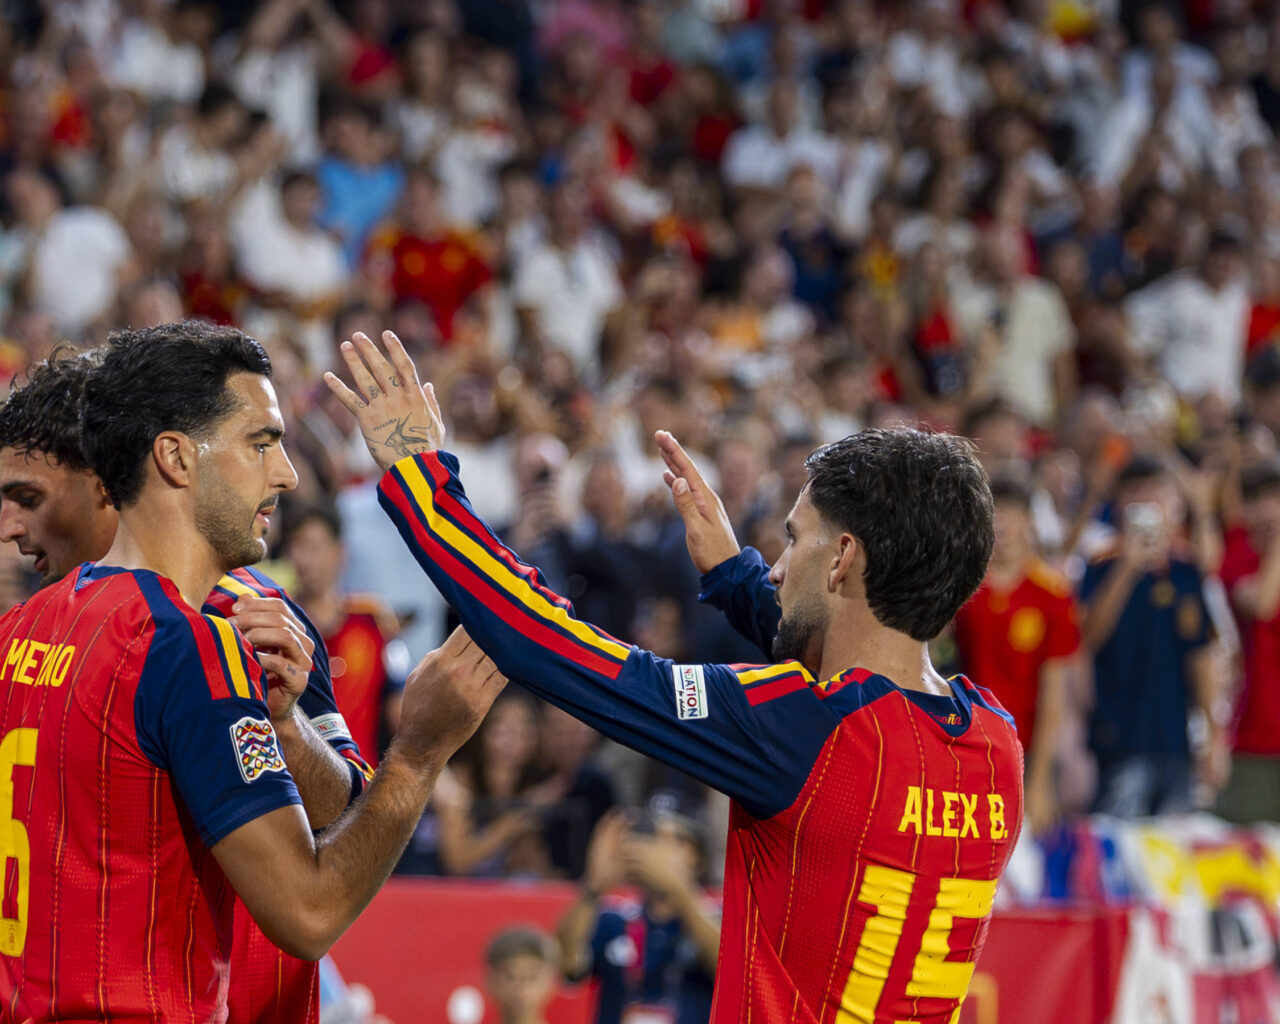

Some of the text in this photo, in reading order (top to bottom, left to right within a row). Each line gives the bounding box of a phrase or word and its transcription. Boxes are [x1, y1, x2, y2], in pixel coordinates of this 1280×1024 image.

[684, 668, 699, 717] NDATION
[898, 786, 1009, 839] ALEX B.
